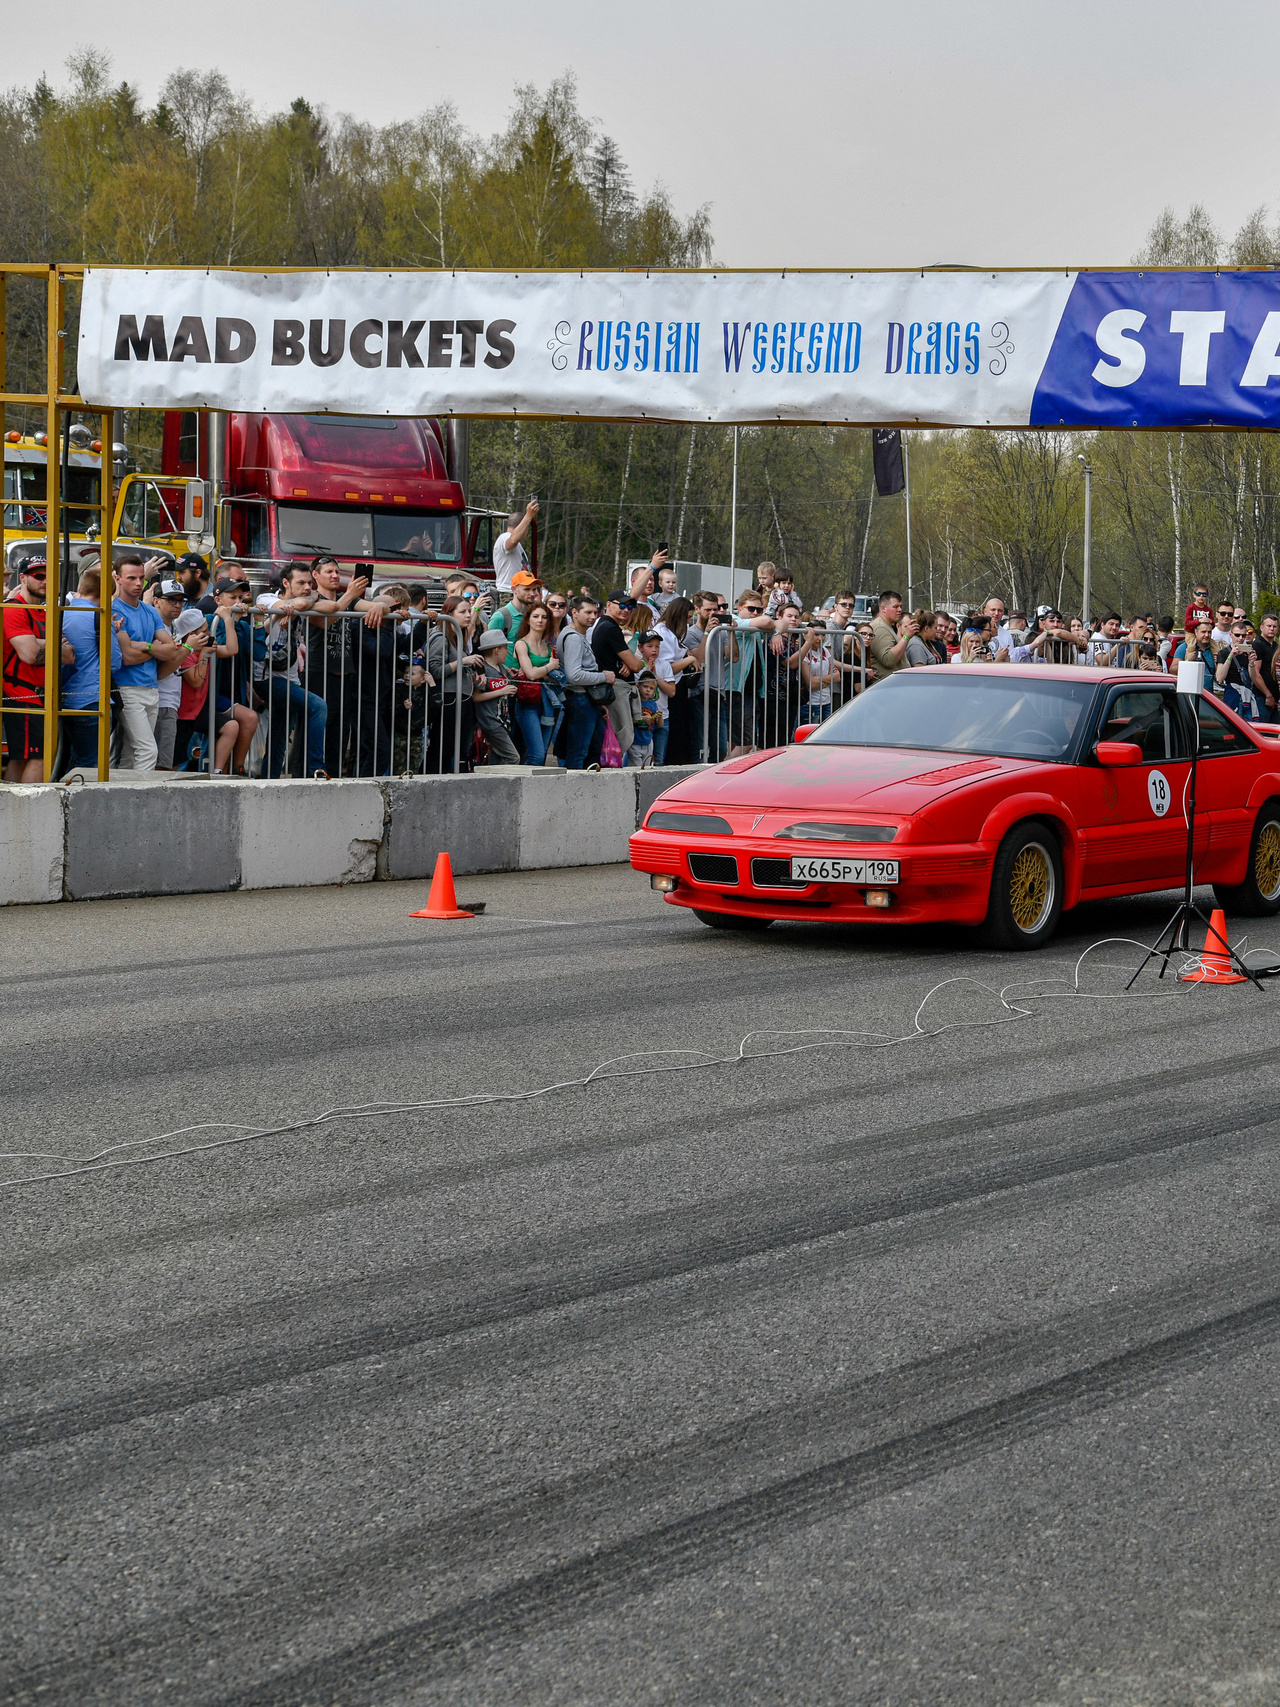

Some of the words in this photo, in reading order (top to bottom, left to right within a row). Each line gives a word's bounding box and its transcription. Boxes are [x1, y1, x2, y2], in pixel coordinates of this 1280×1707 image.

[114, 314, 257, 364] MAD
[271, 318, 517, 370] BUCKETS
[577, 320, 701, 374] RUSSIAN
[723, 321, 862, 374] WEEKEND
[885, 321, 981, 375] DRAGS
[1152, 778, 1166, 800] 18
[868, 862, 894, 876] 190
